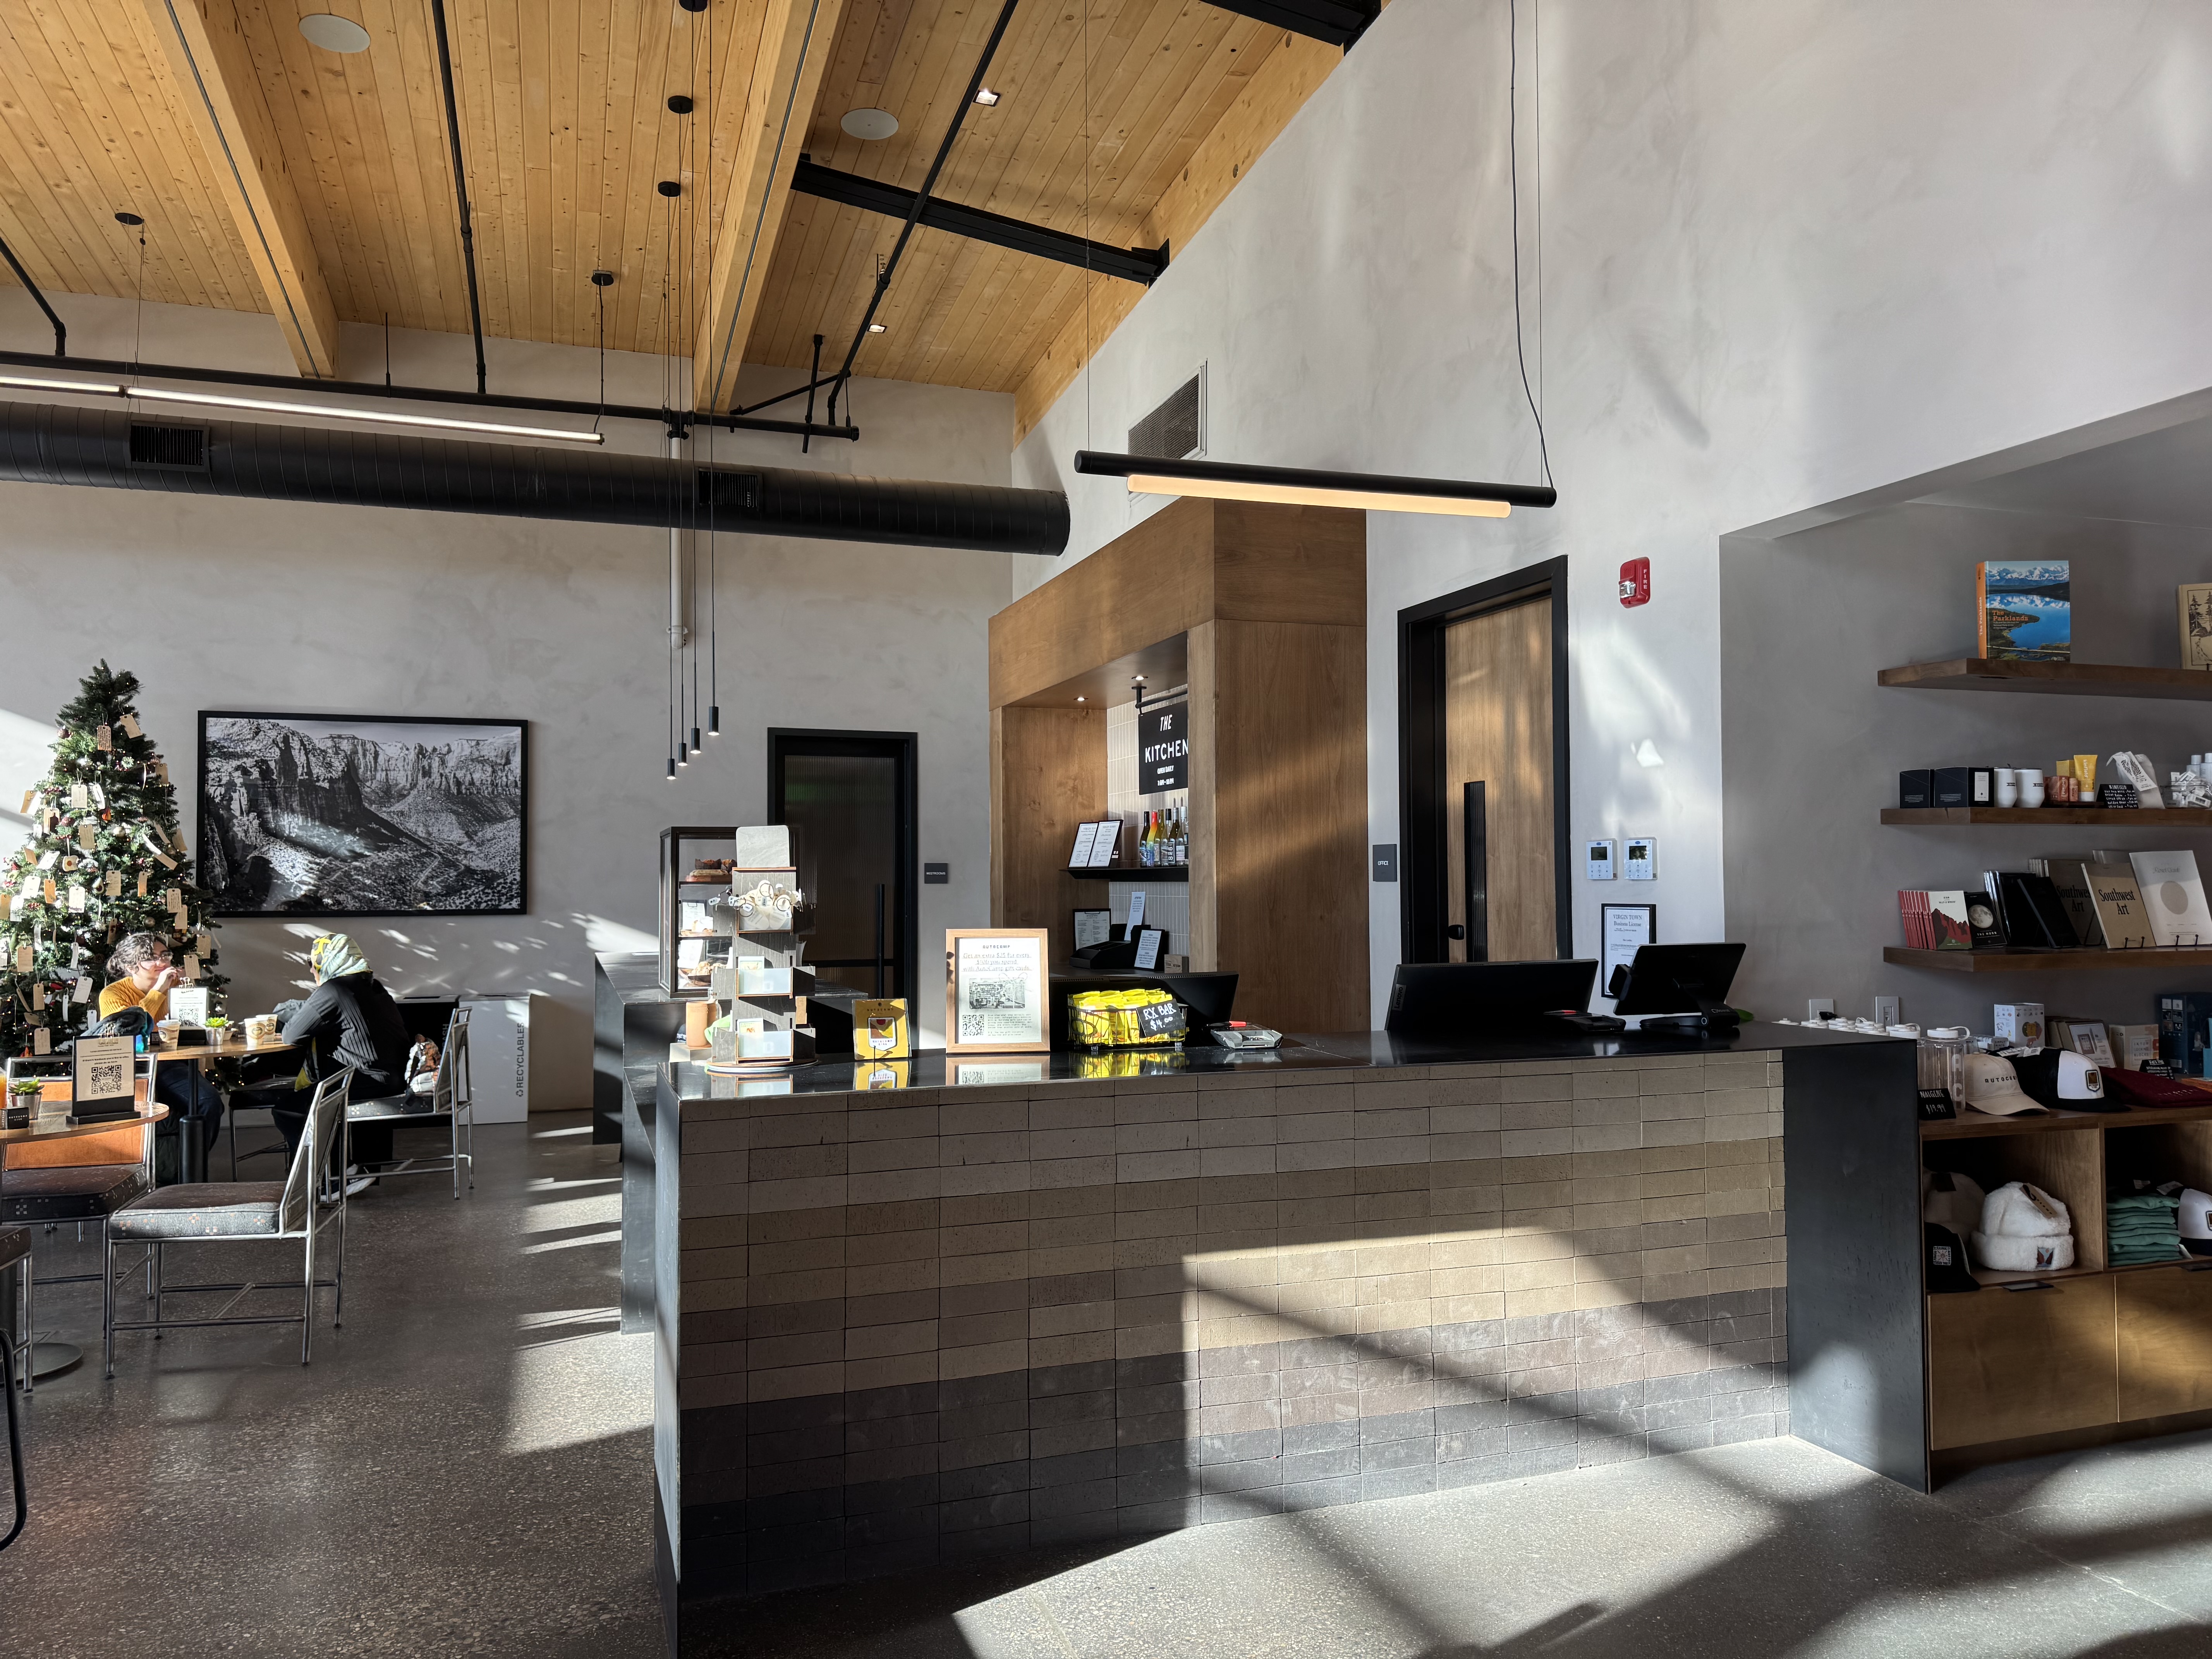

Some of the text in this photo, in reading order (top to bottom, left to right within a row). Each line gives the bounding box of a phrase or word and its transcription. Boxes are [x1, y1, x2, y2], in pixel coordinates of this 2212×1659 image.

[1160, 714, 1173, 731] THE
[1145, 738, 1188, 763] KITCHEN
[2057, 885, 2092, 899] Southwes
[2098, 888, 2135, 902] Southwest
[2072, 899, 2084, 912] Art
[2117, 902, 2130, 915] Art
[1394, 987, 1403, 1008] Lenovo
[1143, 1003, 1177, 1020] RX BAR
[1150, 1017, 1173, 1031] $4.00
[1920, 1090, 1945, 1098] NALGENE
[1926, 1104, 1946, 1115] $19.99
